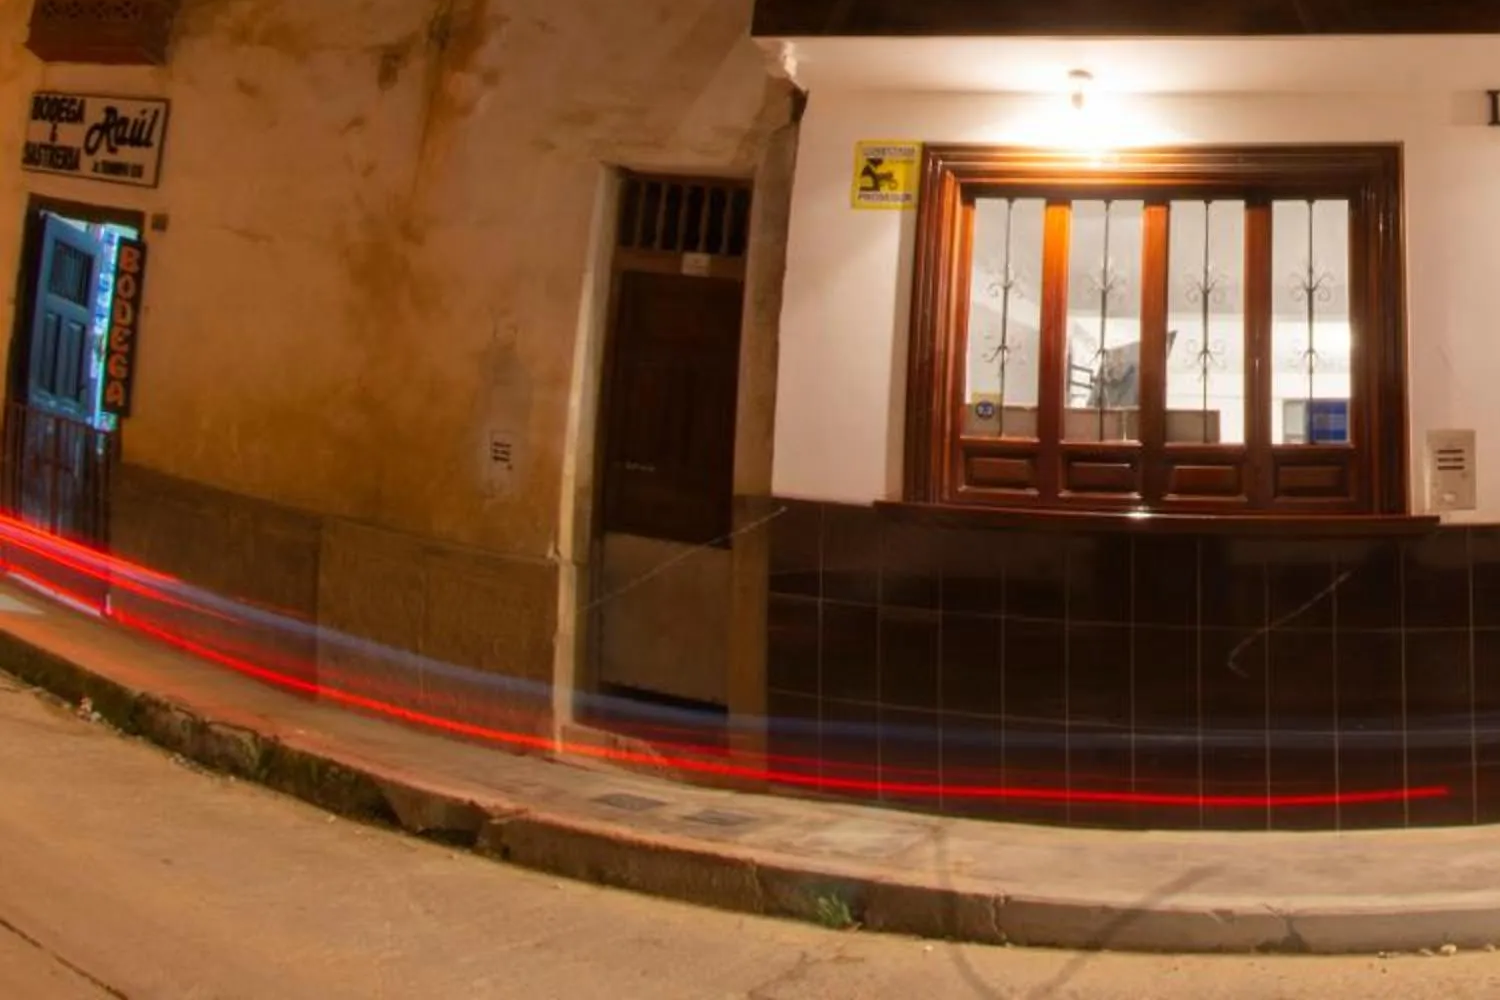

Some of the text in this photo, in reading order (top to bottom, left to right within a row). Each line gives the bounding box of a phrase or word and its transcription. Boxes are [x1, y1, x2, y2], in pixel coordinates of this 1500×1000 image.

[31, 95, 86, 124] BODEGA
[84, 106, 159, 155] Raúl
[105, 244, 140, 407] BODEGA
